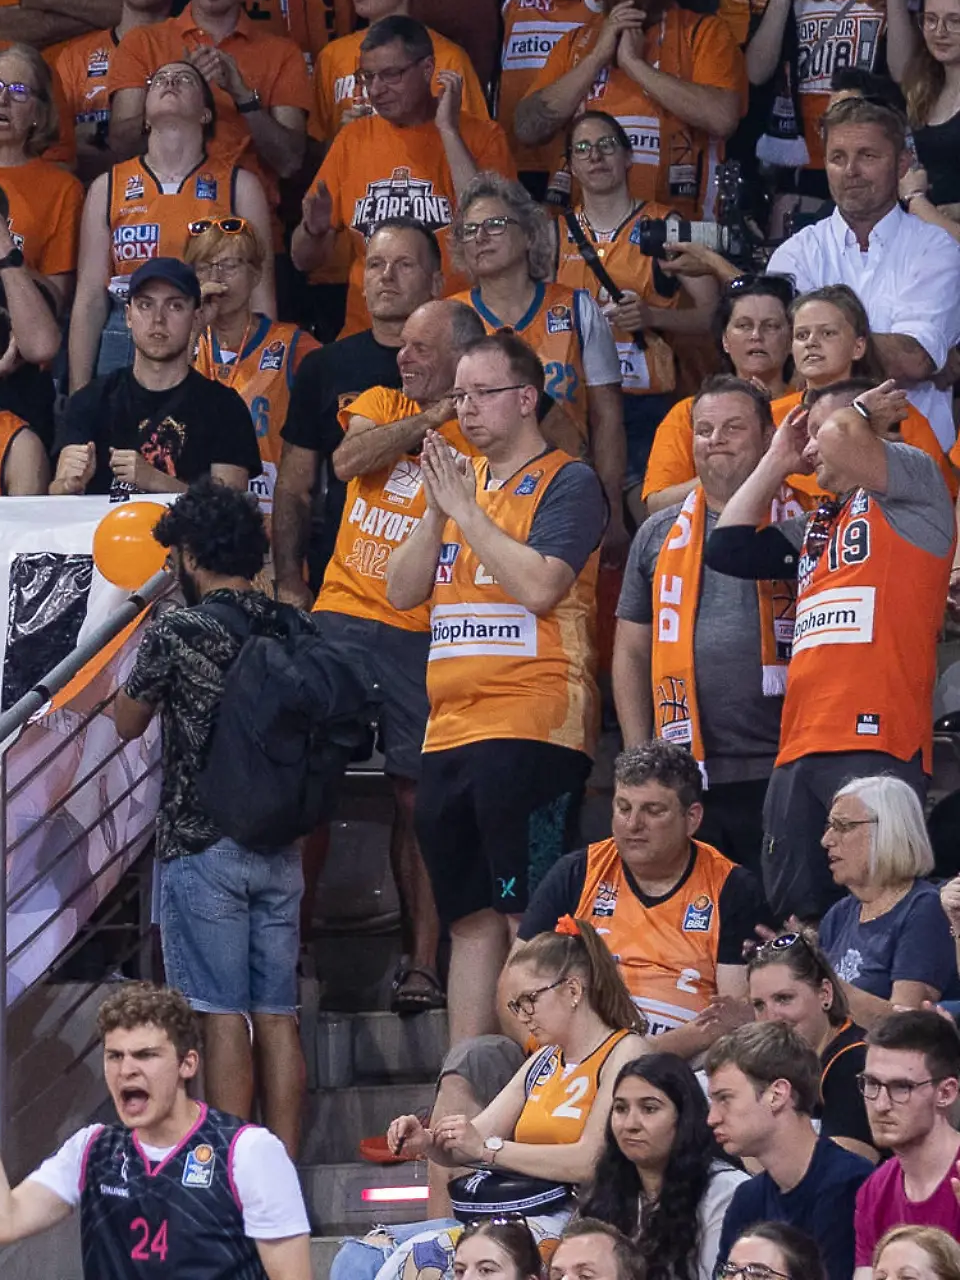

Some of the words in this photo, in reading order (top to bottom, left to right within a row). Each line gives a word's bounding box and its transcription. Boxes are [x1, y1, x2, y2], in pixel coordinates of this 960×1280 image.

[511, 35, 552, 54] ratio
[412, 197, 452, 226] ONE
[111, 225, 157, 243] LIQUI
[250, 396, 270, 438] 6
[345, 537, 392, 580] 202
[827, 518, 872, 573] 19
[431, 620, 520, 642] tiopharm
[686, 919, 709, 930] BBL
[675, 968, 701, 995] 2
[550, 1075, 591, 1120] 2
[129, 1217, 170, 1262] 24
